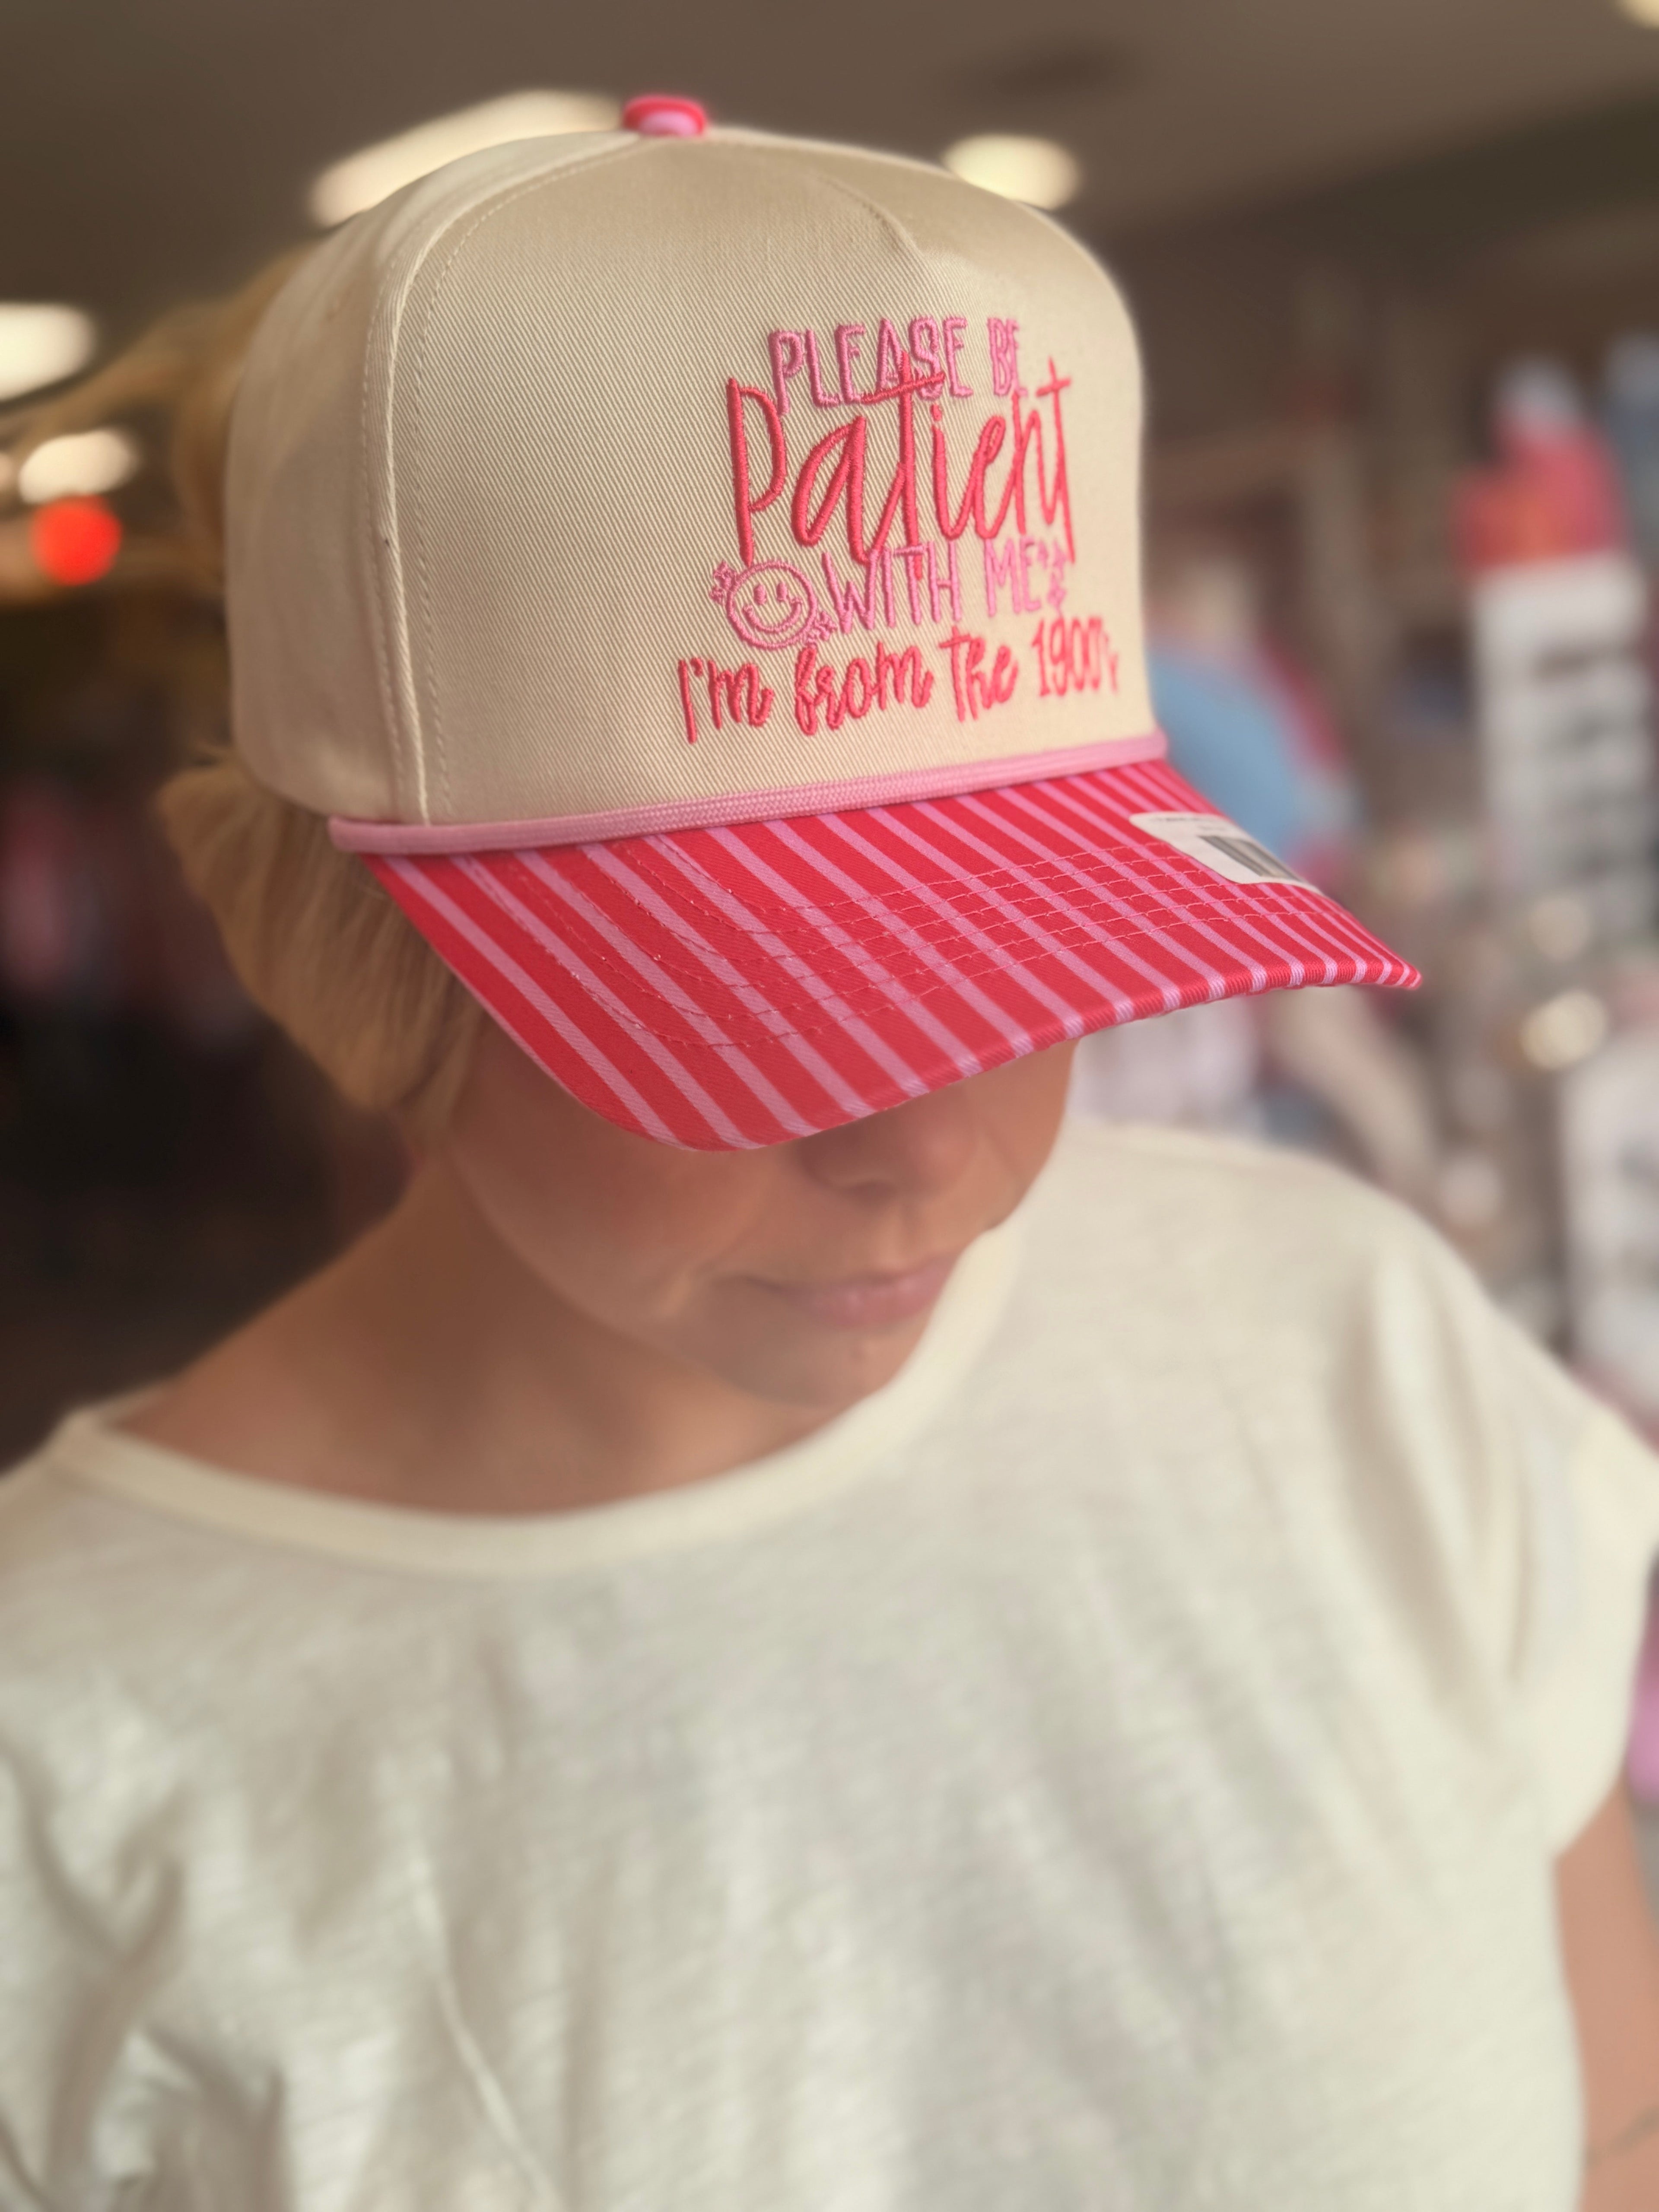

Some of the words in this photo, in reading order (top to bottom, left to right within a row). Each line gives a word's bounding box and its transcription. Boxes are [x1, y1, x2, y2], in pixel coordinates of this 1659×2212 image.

[768, 317, 973, 416] PLEASE
[988, 318, 1027, 398] BE
[822, 540, 962, 633] WITH
[984, 537, 1041, 618] ME
[679, 658, 773, 744] I'm
[795, 644, 933, 736] from
